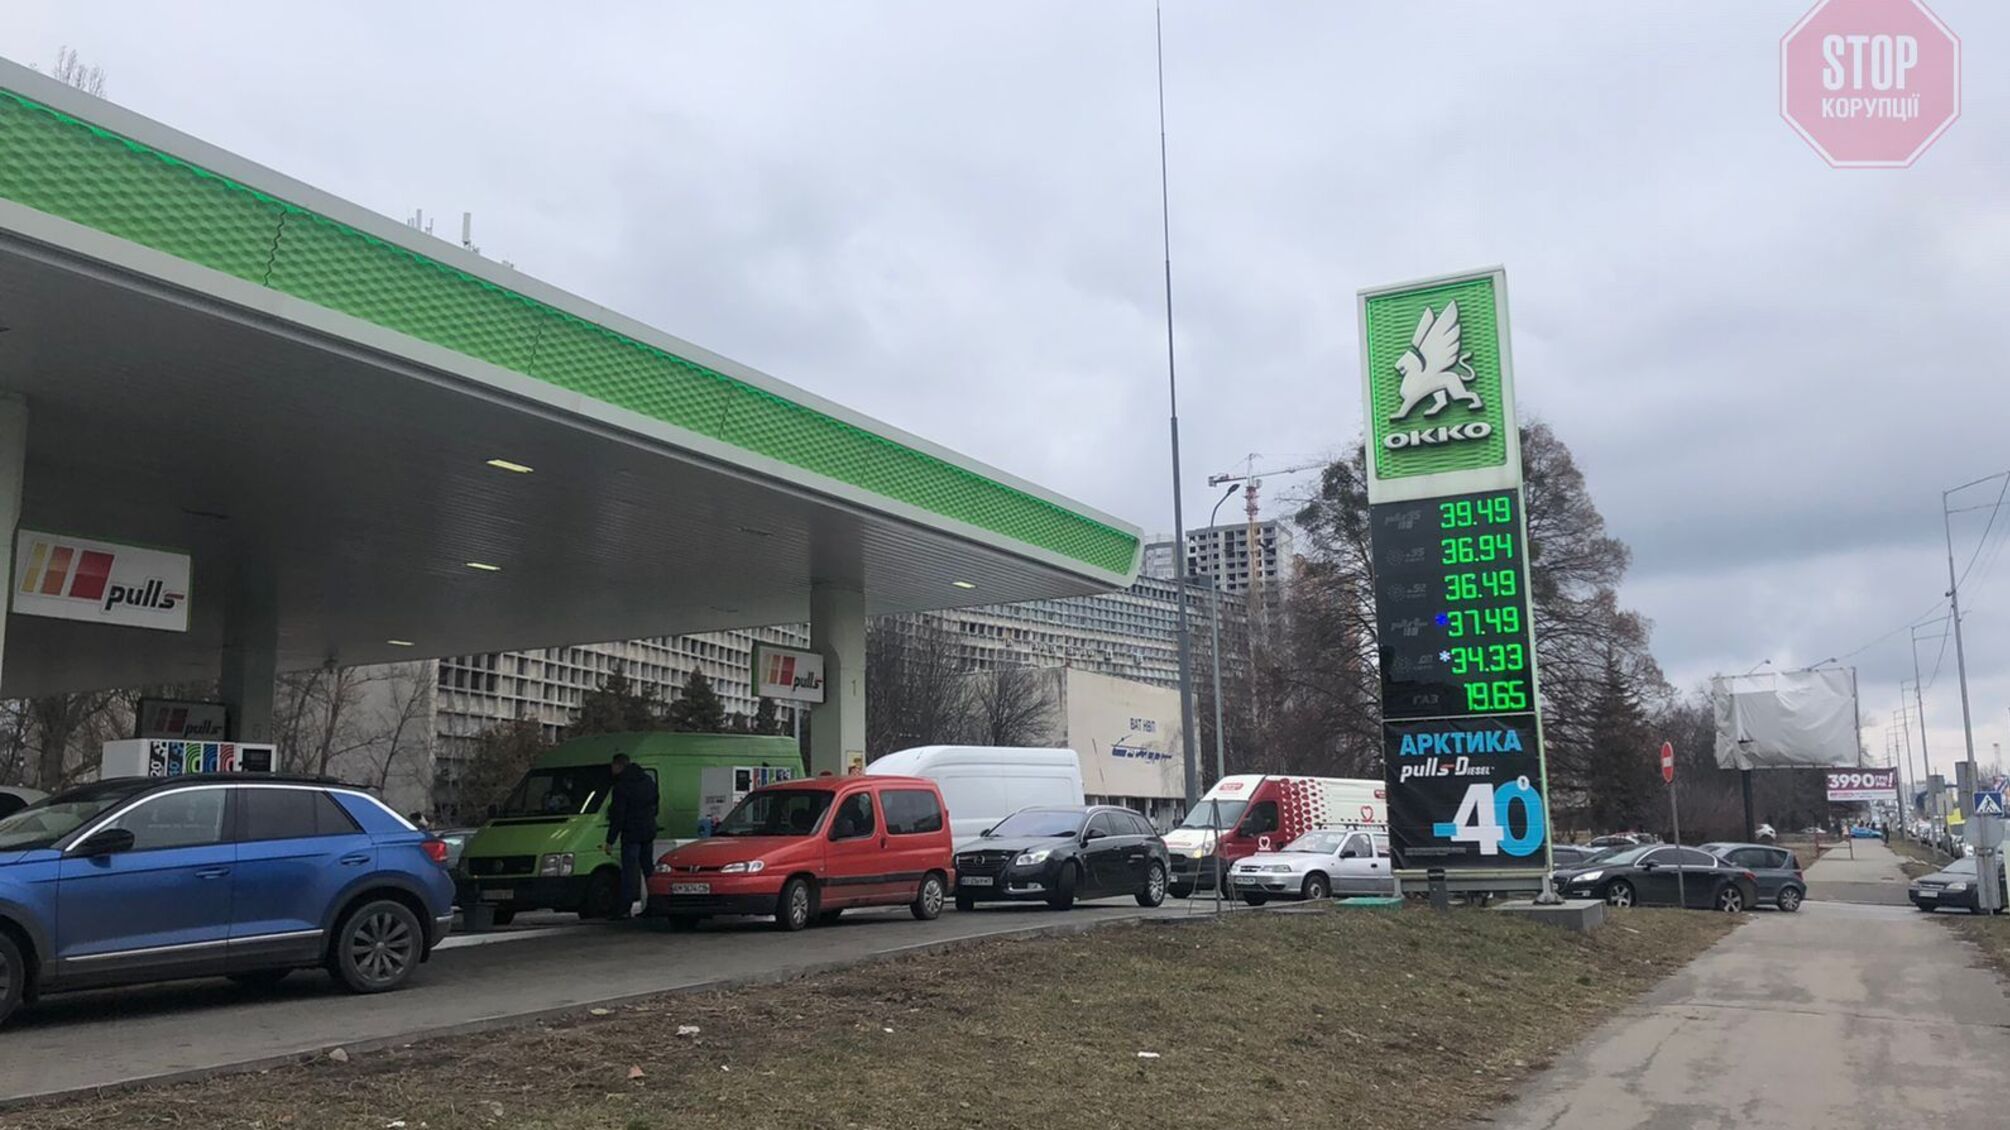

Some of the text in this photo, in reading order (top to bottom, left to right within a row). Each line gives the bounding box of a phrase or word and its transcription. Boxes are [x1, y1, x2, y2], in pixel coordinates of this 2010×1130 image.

[1384, 422, 1493, 449] OKKO
[1439, 497, 1511, 528] 39.49
[1441, 533, 1512, 564] 36.94
[104, 579, 185, 611] pulls
[1444, 569, 1516, 600] 36.49
[1447, 606, 1519, 637] 37.49
[1451, 644, 1523, 674] 34.33
[793, 671, 823, 692] pulls
[1464, 680, 1526, 711] 19.65
[1400, 729, 1523, 756] АРКТИКА
[1400, 757, 1455, 783] pulls
[1827, 773, 1875, 789] 3990
